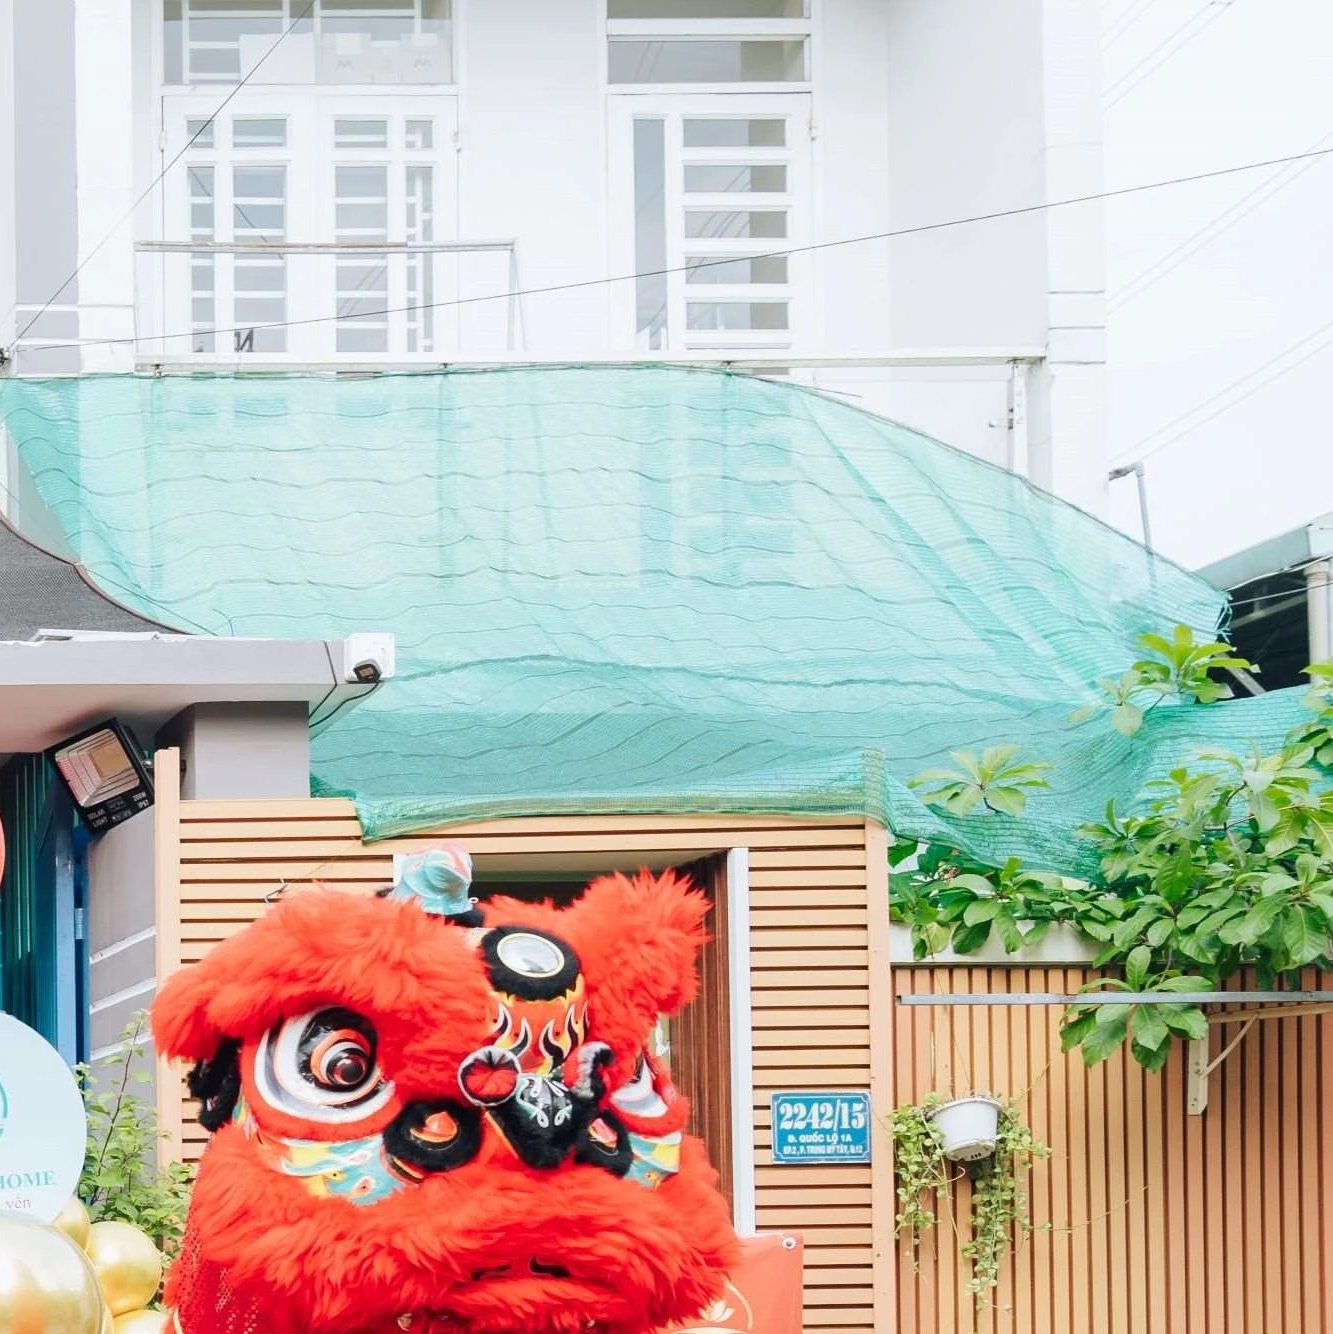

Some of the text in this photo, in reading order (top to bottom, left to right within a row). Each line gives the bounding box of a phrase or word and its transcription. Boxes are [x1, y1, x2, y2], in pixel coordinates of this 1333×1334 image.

[779, 1099, 866, 1131] 2242/15
[799, 1131, 824, 1143] QUỐC
[841, 1134, 853, 1142] 1A
